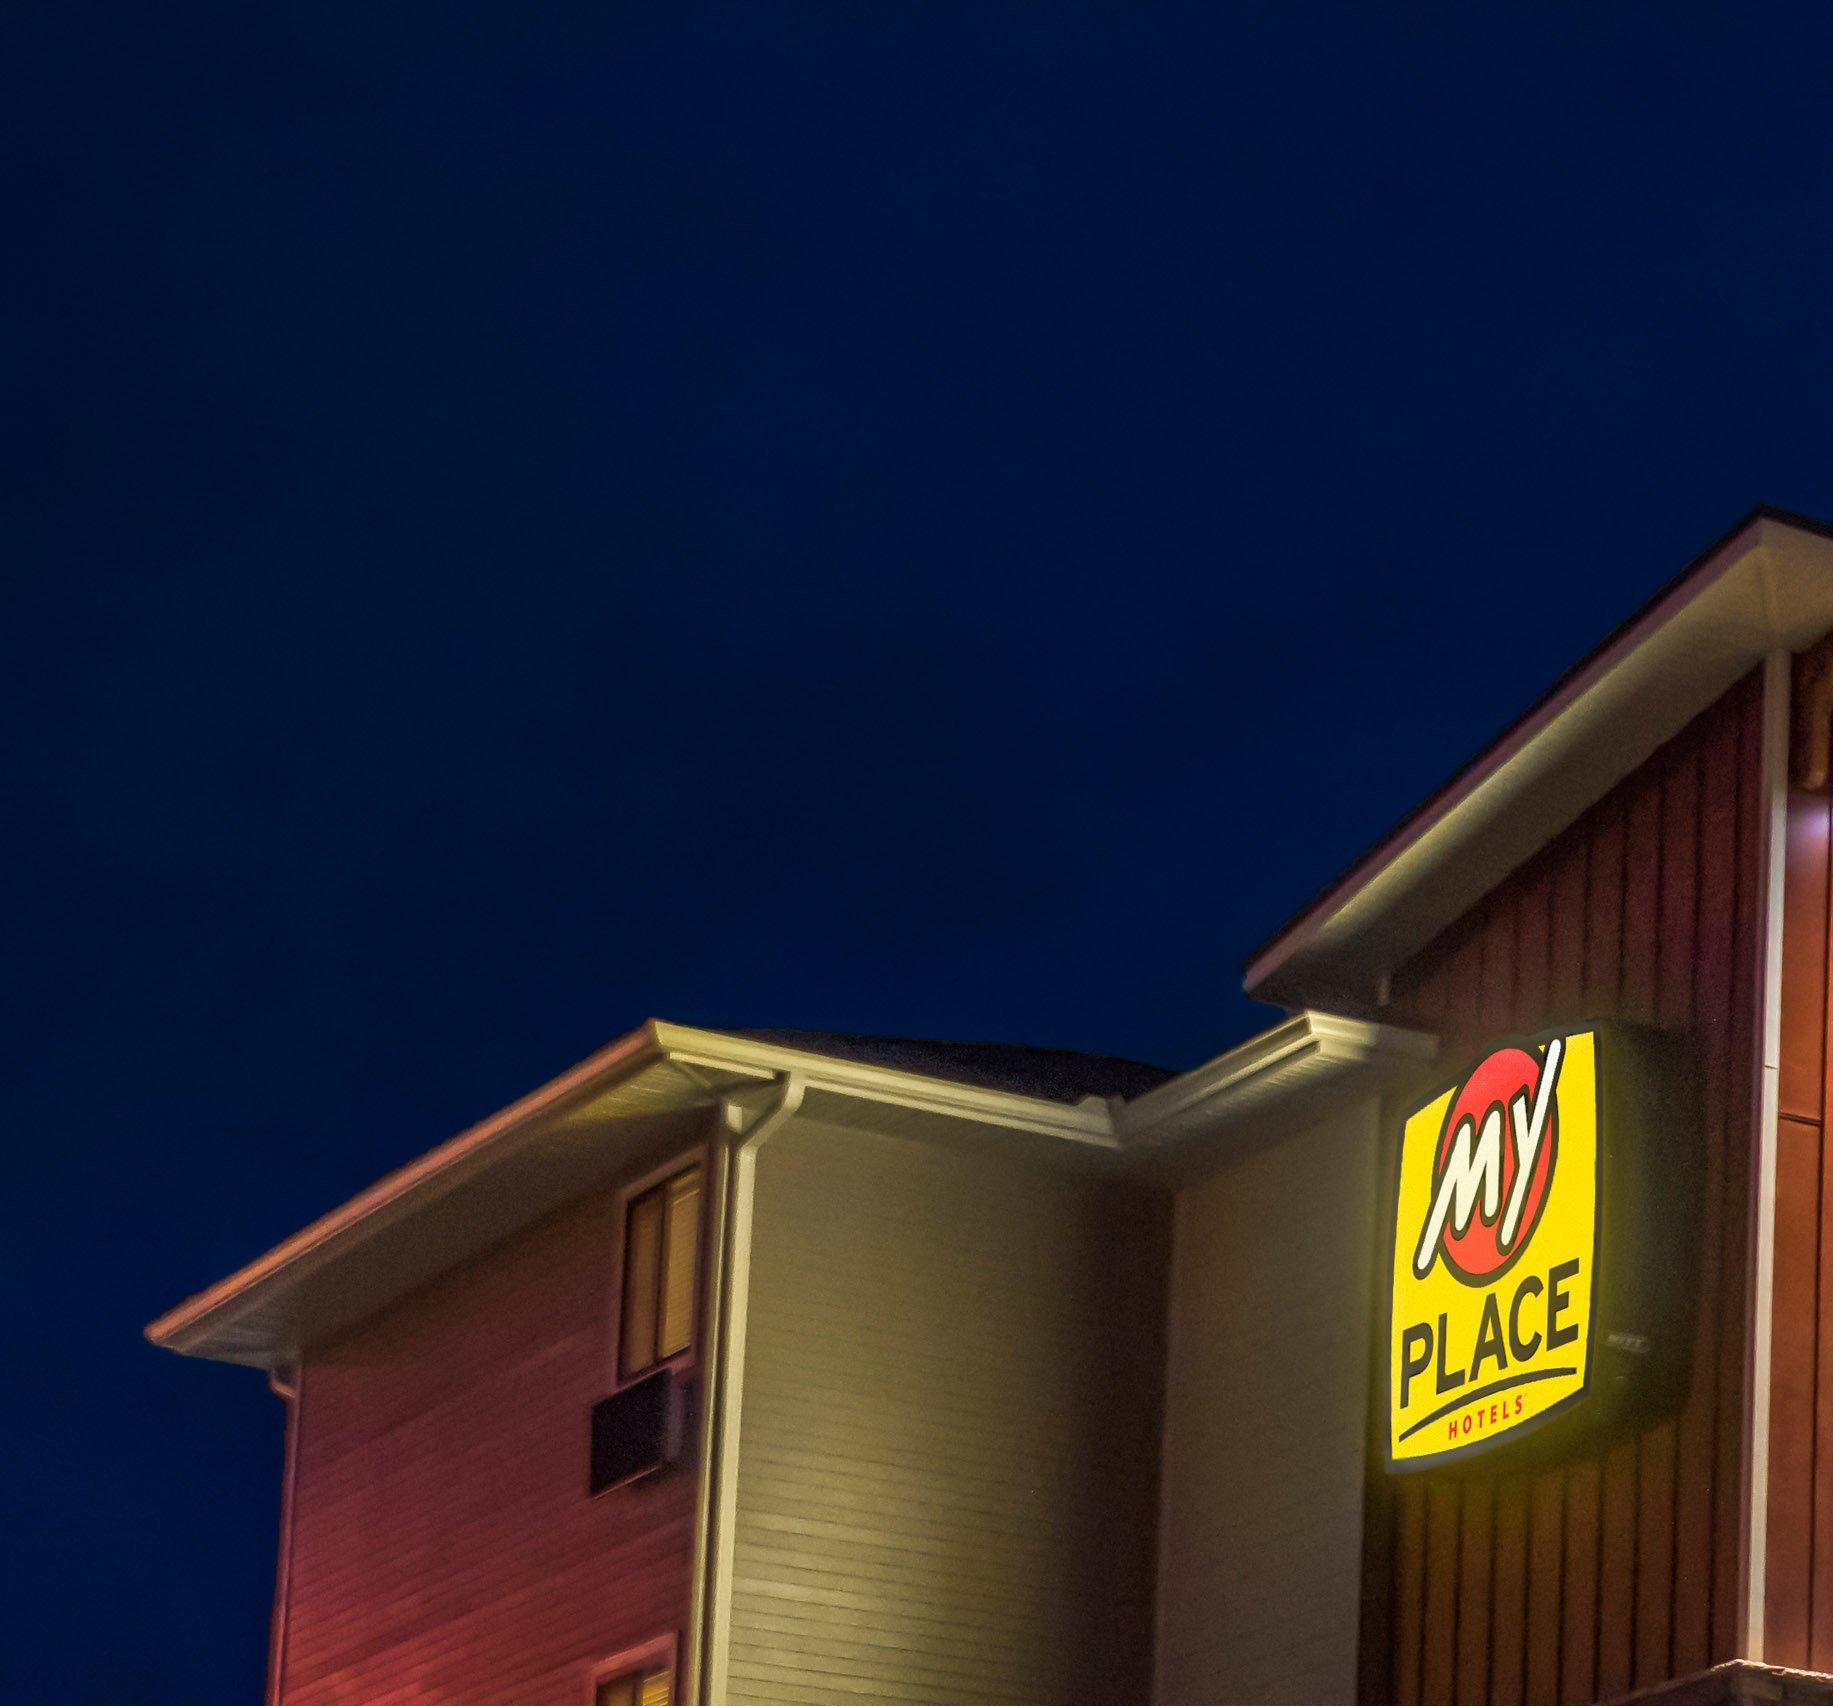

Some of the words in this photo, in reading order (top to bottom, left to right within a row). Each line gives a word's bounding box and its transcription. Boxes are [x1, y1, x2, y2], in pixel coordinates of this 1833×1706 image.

[1417, 1039, 1561, 1271] MY
[1401, 1257, 1579, 1409] PLACE
[1448, 1394, 1524, 1440] HOTELS
